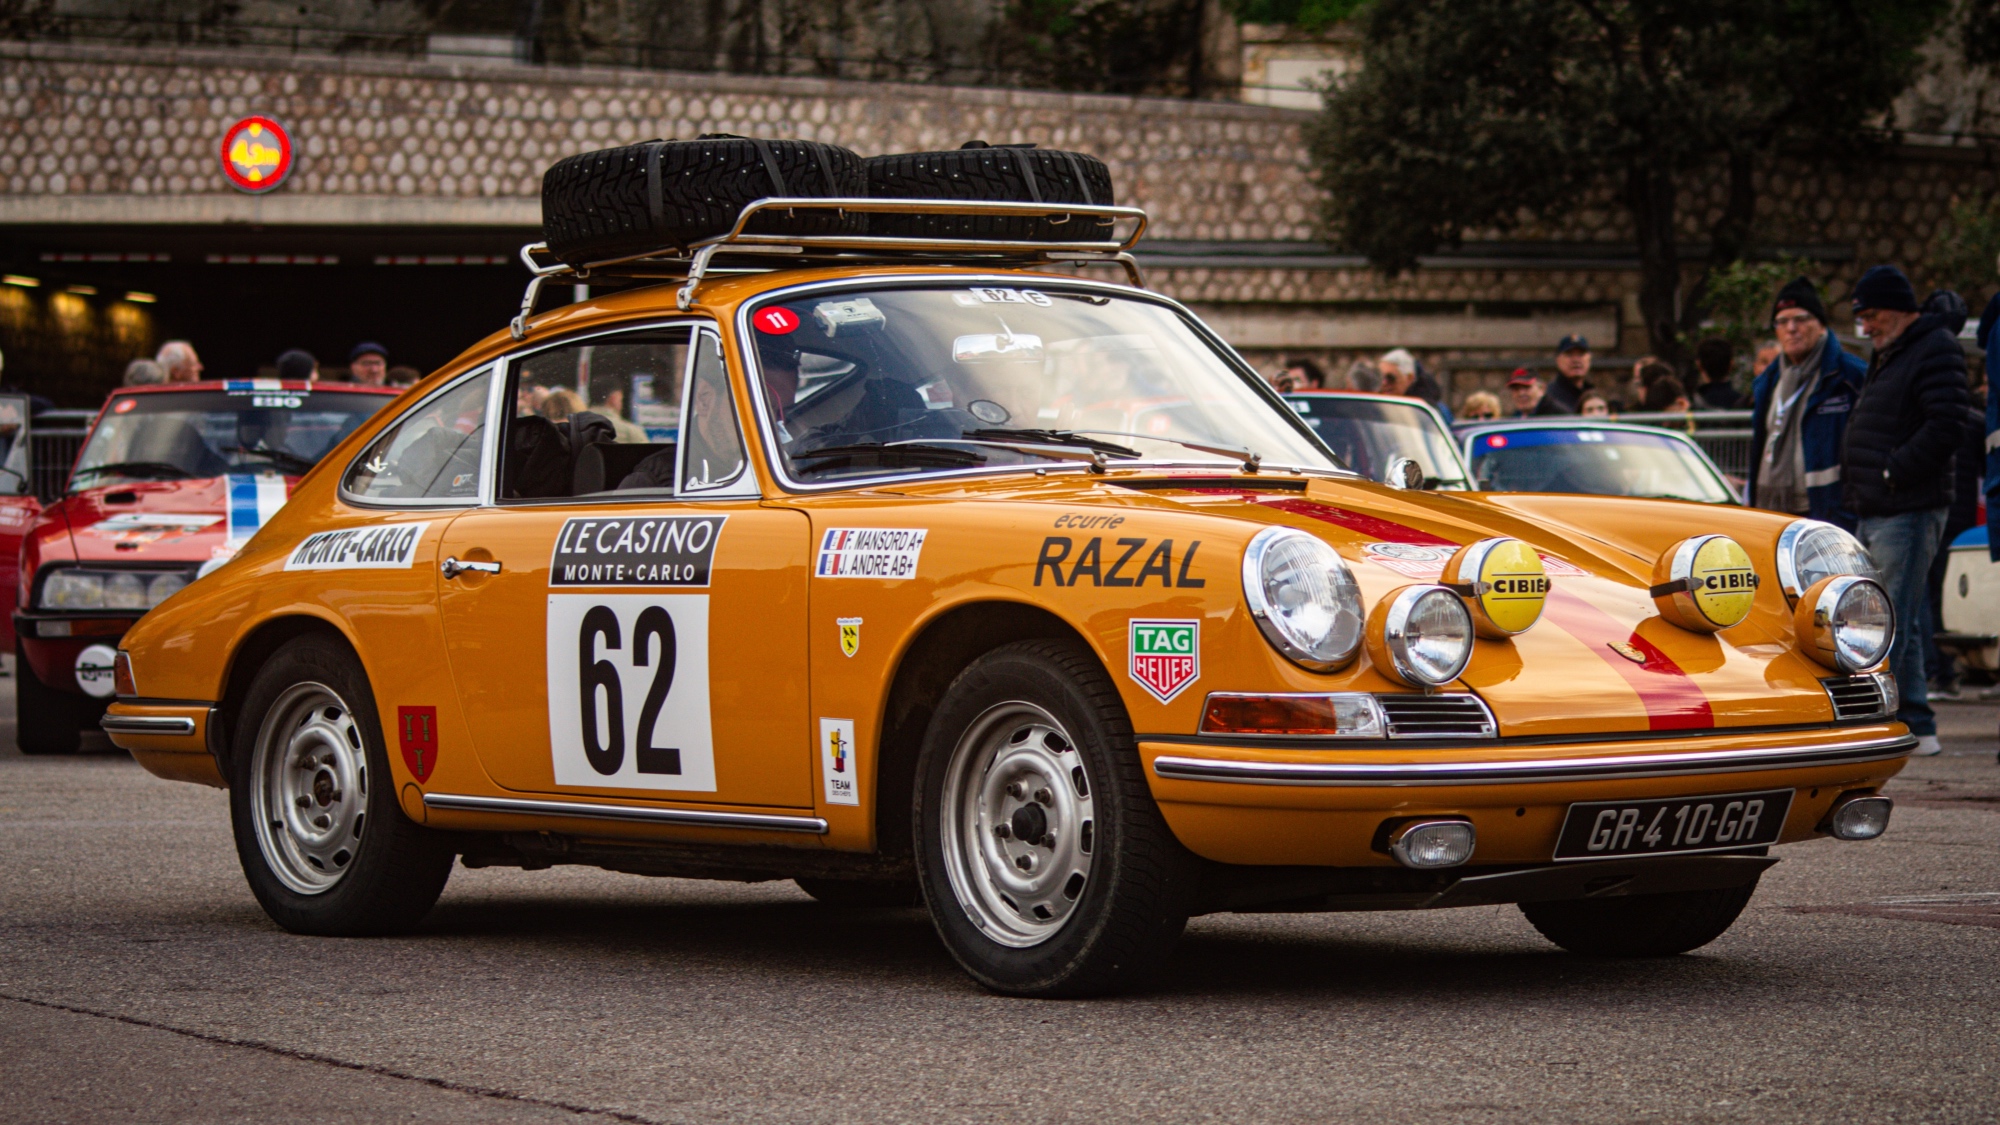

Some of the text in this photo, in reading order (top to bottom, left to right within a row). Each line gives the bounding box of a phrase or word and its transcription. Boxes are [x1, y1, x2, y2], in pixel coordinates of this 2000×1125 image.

[983, 289, 1047, 303] 62 E
[766, 312, 788, 328] 11
[1053, 512, 1125, 530] écurie
[292, 526, 418, 565] MONTE-CARLO
[560, 520, 713, 554] LE CASINO
[843, 530, 923, 551] F. MANSORD A+
[838, 554, 913, 576] J. ANDRE AB+
[1033, 536, 1206, 588] RAZAL
[1138, 629, 1190, 651] TAG
[1136, 658, 1191, 691] HEUER
[579, 605, 682, 776] 62
[831, 779, 851, 790] TEAM
